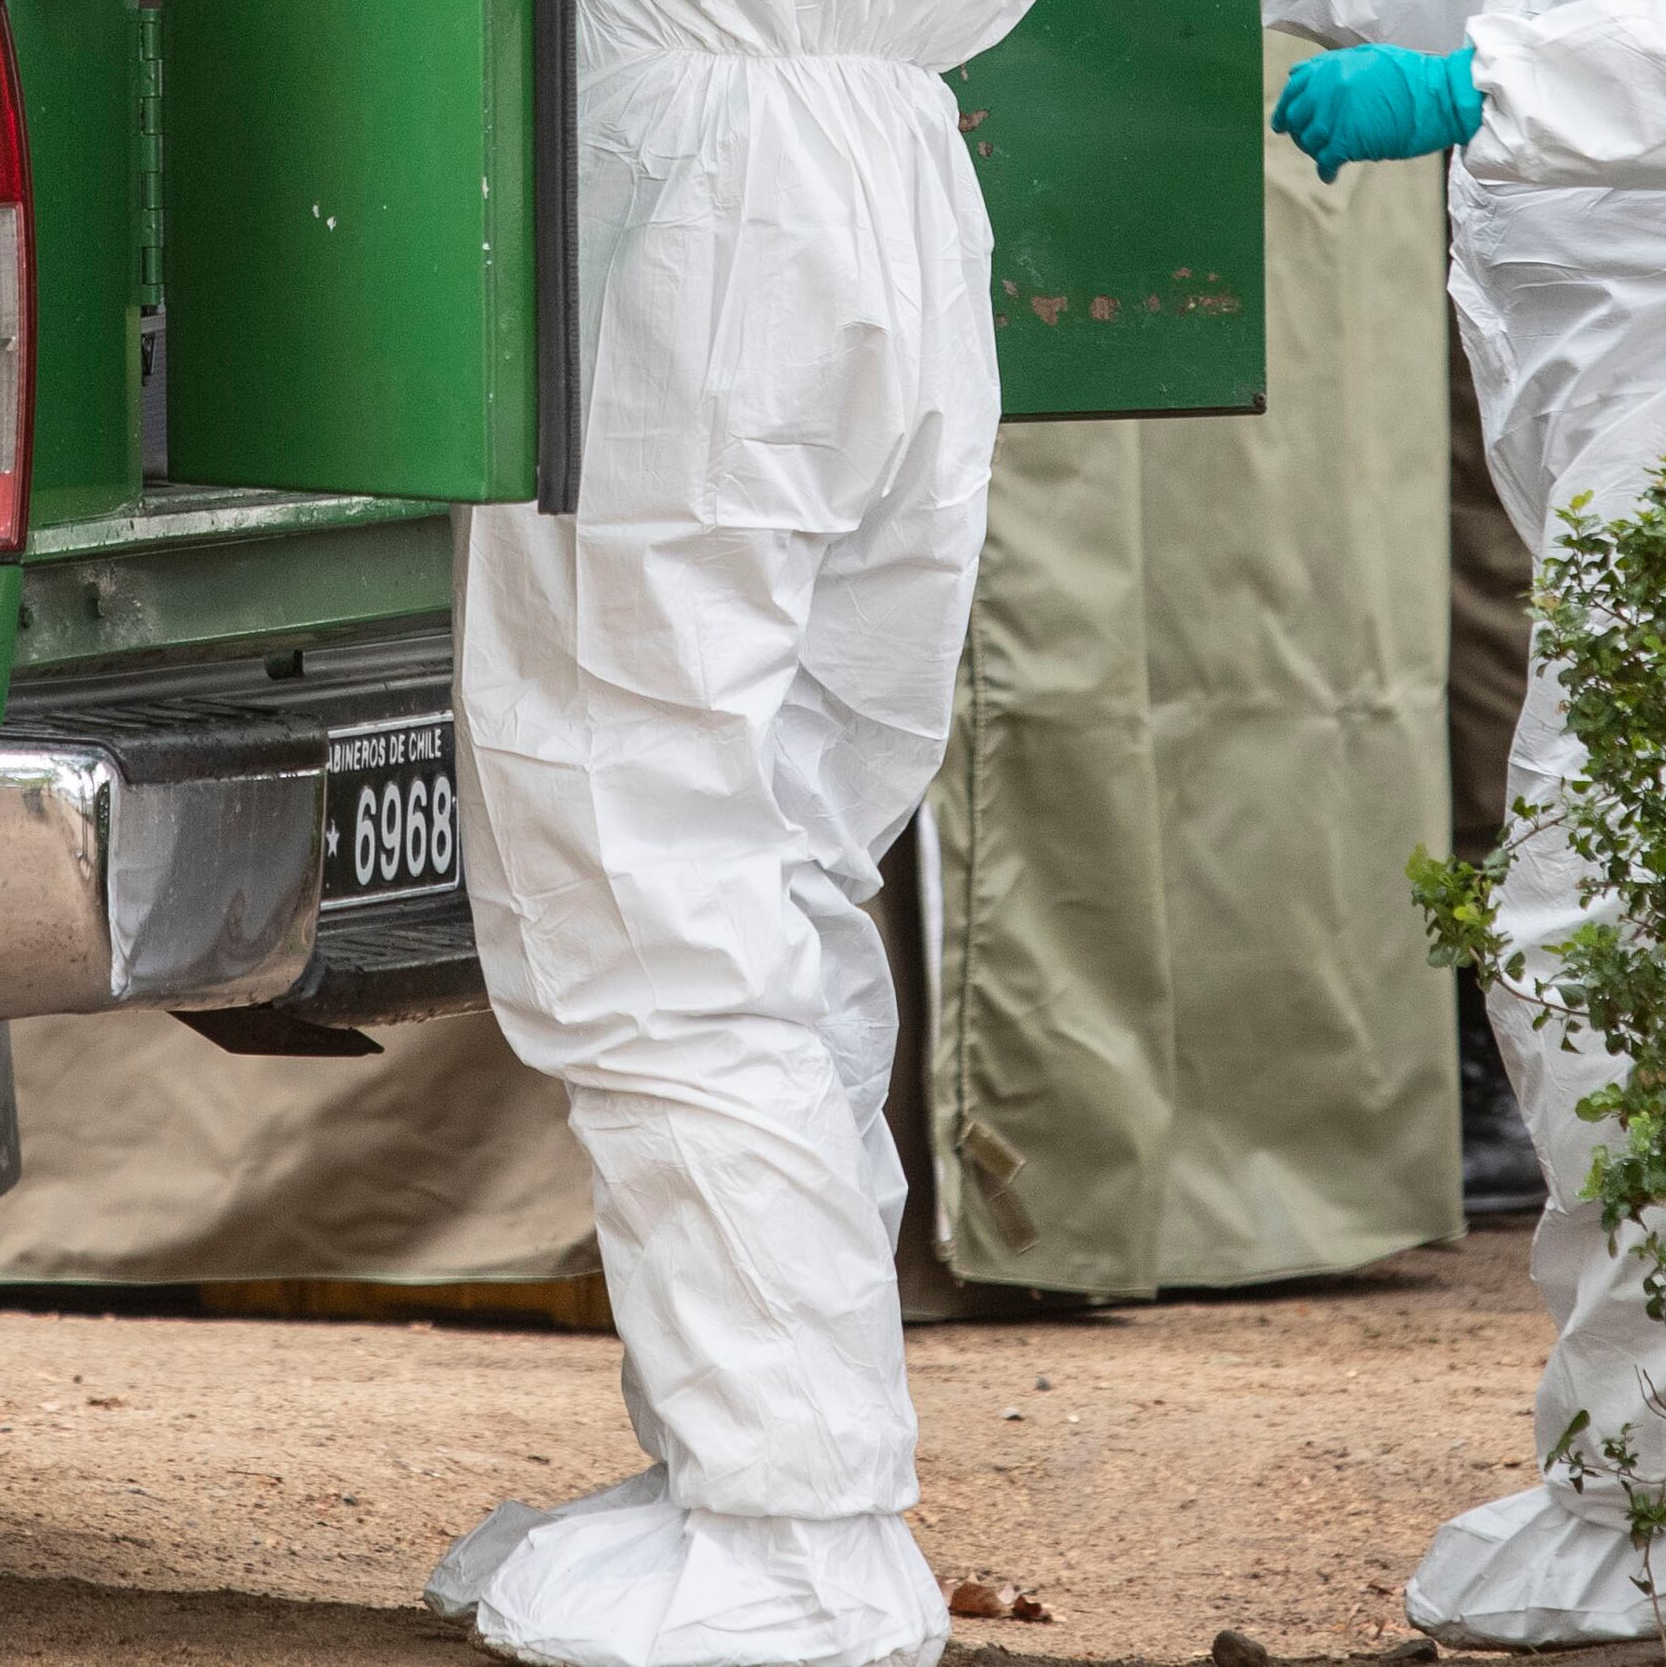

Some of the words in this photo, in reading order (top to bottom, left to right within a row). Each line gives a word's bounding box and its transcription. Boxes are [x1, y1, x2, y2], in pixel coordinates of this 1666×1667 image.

[388, 733, 406, 766] DE
[408, 728, 442, 762] CHILE
[354, 775, 453, 885] 6968
